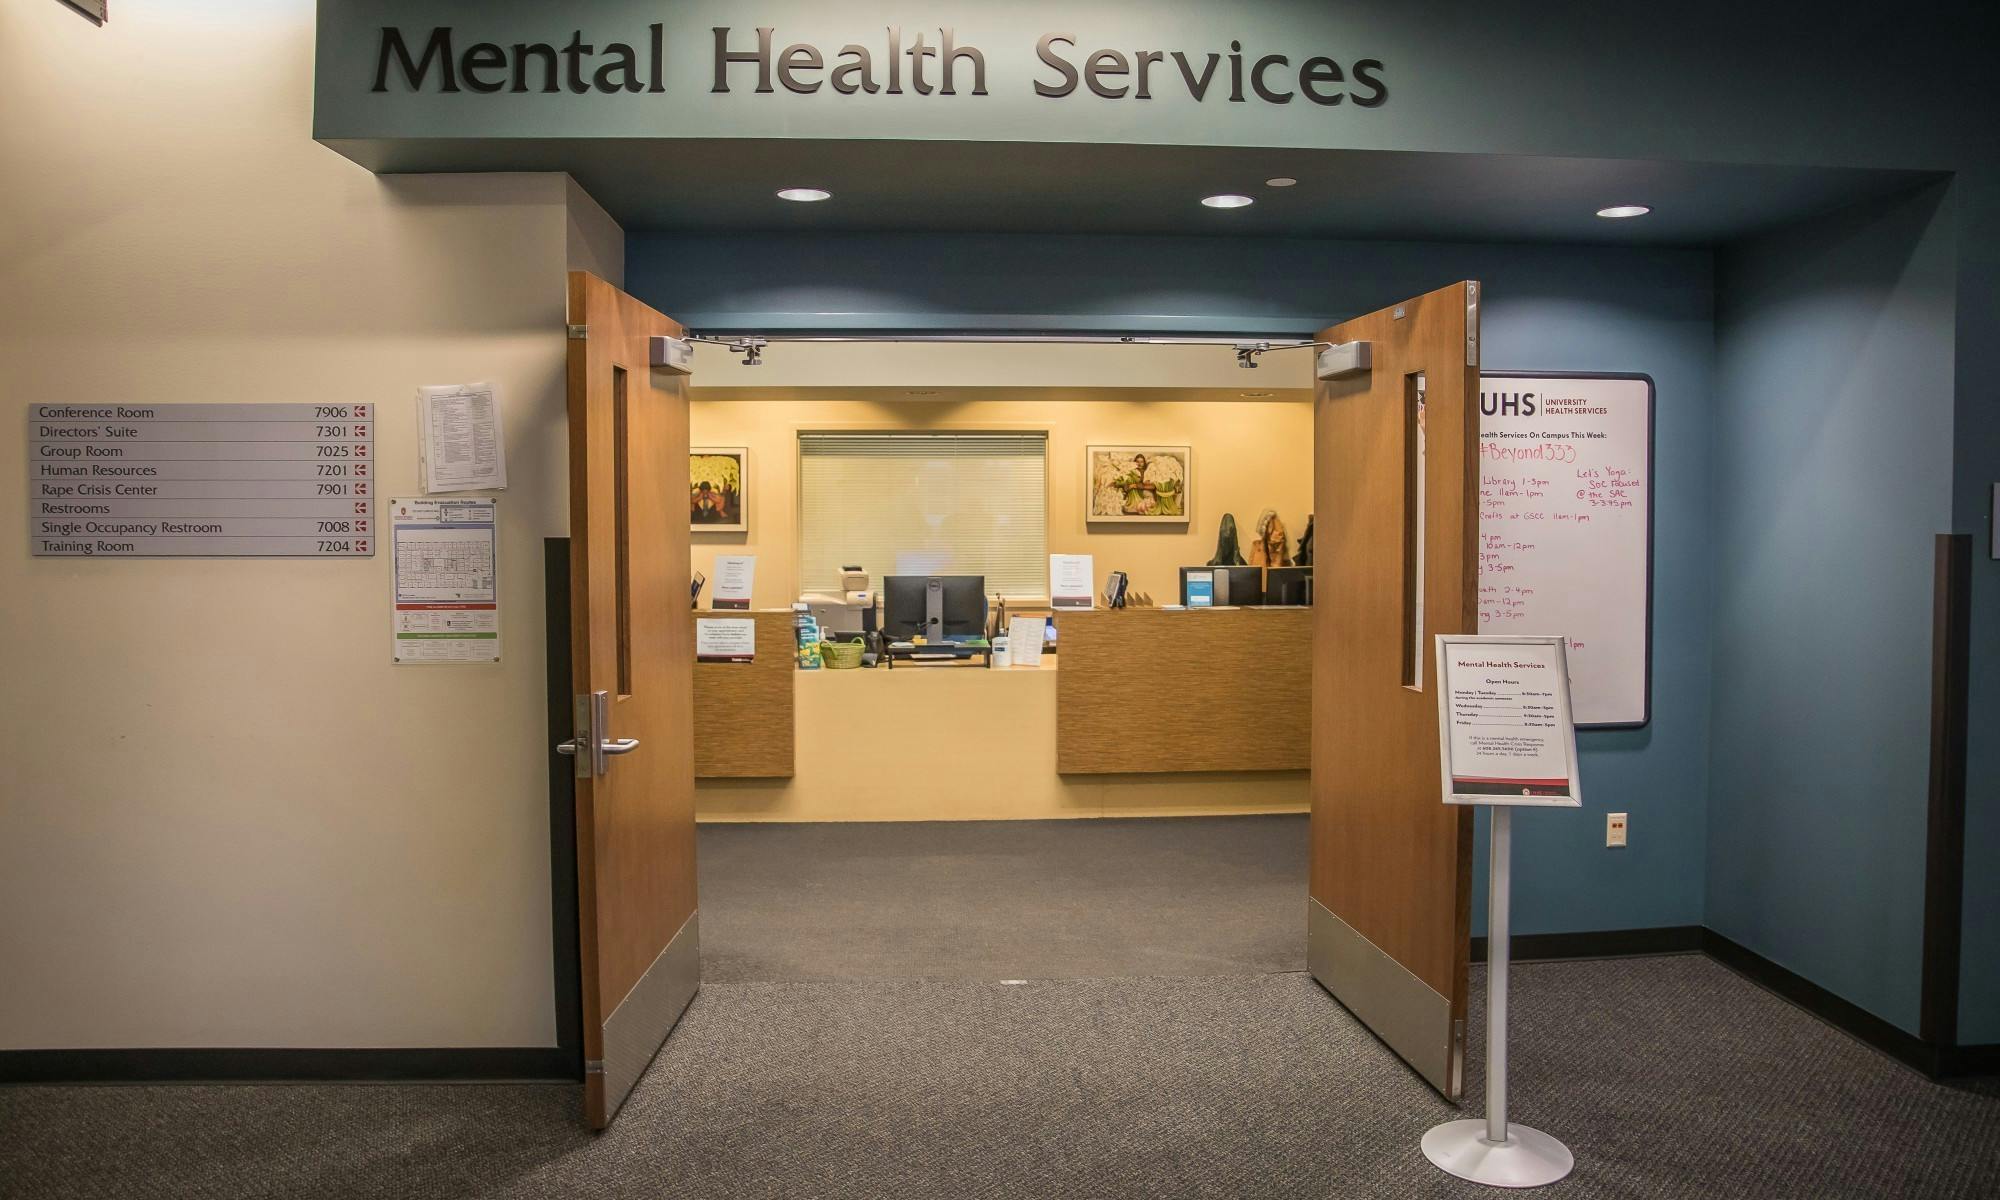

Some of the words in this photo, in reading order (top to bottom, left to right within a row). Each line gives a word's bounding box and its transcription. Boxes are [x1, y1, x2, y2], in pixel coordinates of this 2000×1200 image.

[370, 22, 666, 95] Mental
[710, 26, 989, 96] Health
[1033, 30, 1390, 109] Services
[1481, 393, 1536, 416] UHS
[1545, 407, 1573, 415] HEALTH
[1575, 407, 1608, 415] SERVICES
[39, 406, 113, 419] Conference
[116, 407, 155, 419] Room
[314, 406, 348, 419] 7906
[39, 424, 101, 438] Directors'
[105, 425, 138, 438] Suite
[316, 426, 348, 438] 7301
[1541, 432, 1570, 440] Campus
[40, 446, 82, 459] Group
[85, 446, 123, 457] Room
[316, 445, 349, 458] 7025
[41, 464, 88, 476] Human
[92, 464, 157, 476] Resources
[317, 465, 348, 476] 7201
[1483, 475, 1517, 491] Library
[41, 484, 74, 497] Rape
[77, 484, 112, 496] Crisis
[115, 484, 158, 496] Center
[317, 484, 348, 496] 7901
[1576, 489, 1586, 499] @
[1588, 491, 1603, 499] the
[41, 502, 111, 514] Restrooms
[41, 521, 84, 535] Single
[85, 522, 157, 535] Occupancy
[161, 521, 223, 534] Restroom
[317, 521, 350, 533] 7008
[42, 540, 94, 554] Training
[96, 540, 135, 552] Room
[317, 540, 350, 552] 7204
[1480, 552, 1500, 563] 3pm
[1488, 563, 1514, 573] 3-5pm
[1458, 661, 1485, 669] Mental
[1486, 661, 1513, 669] Health
[1514, 661, 1545, 669] Services
